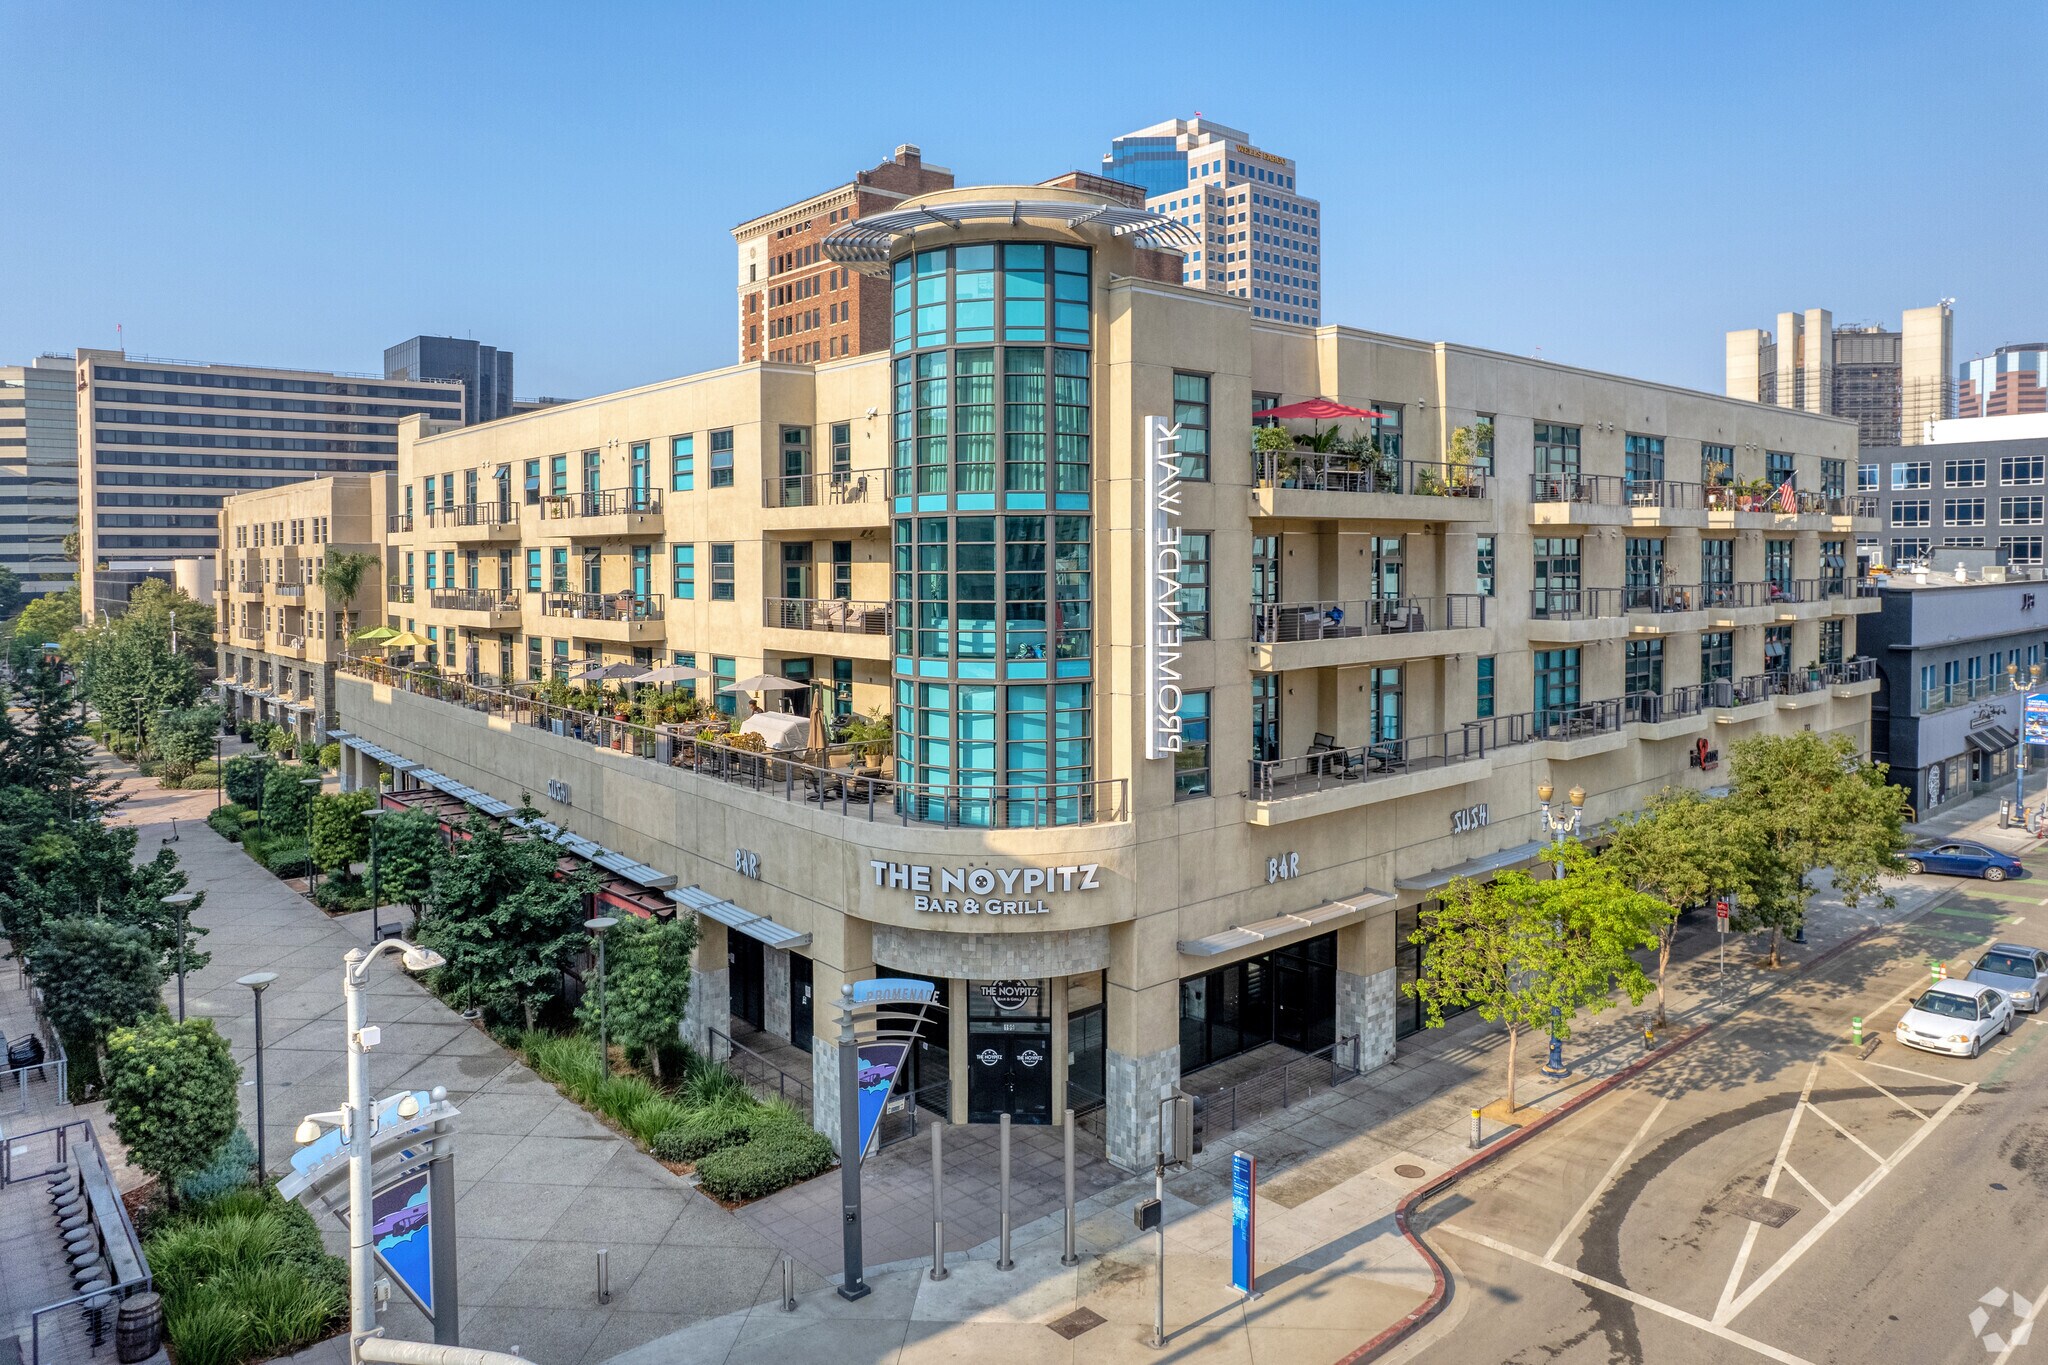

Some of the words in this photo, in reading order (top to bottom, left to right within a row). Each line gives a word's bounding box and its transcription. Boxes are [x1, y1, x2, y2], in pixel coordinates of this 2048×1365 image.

[547, 778, 571, 805] SUSHI
[1452, 803, 1490, 835] SUSHI
[735, 848, 761, 880] BAR
[870, 860, 932, 893] THE
[941, 863, 1100, 895] NOYPITZ
[1268, 851, 1299, 884] BAR
[914, 895, 959, 914] BAR
[963, 898, 980, 915] &
[985, 899, 1050, 915] GRILL
[866, 987, 941, 1005] PROMENADE
[981, 987, 997, 996] THE
[999, 987, 1038, 996] NOYPITZ
